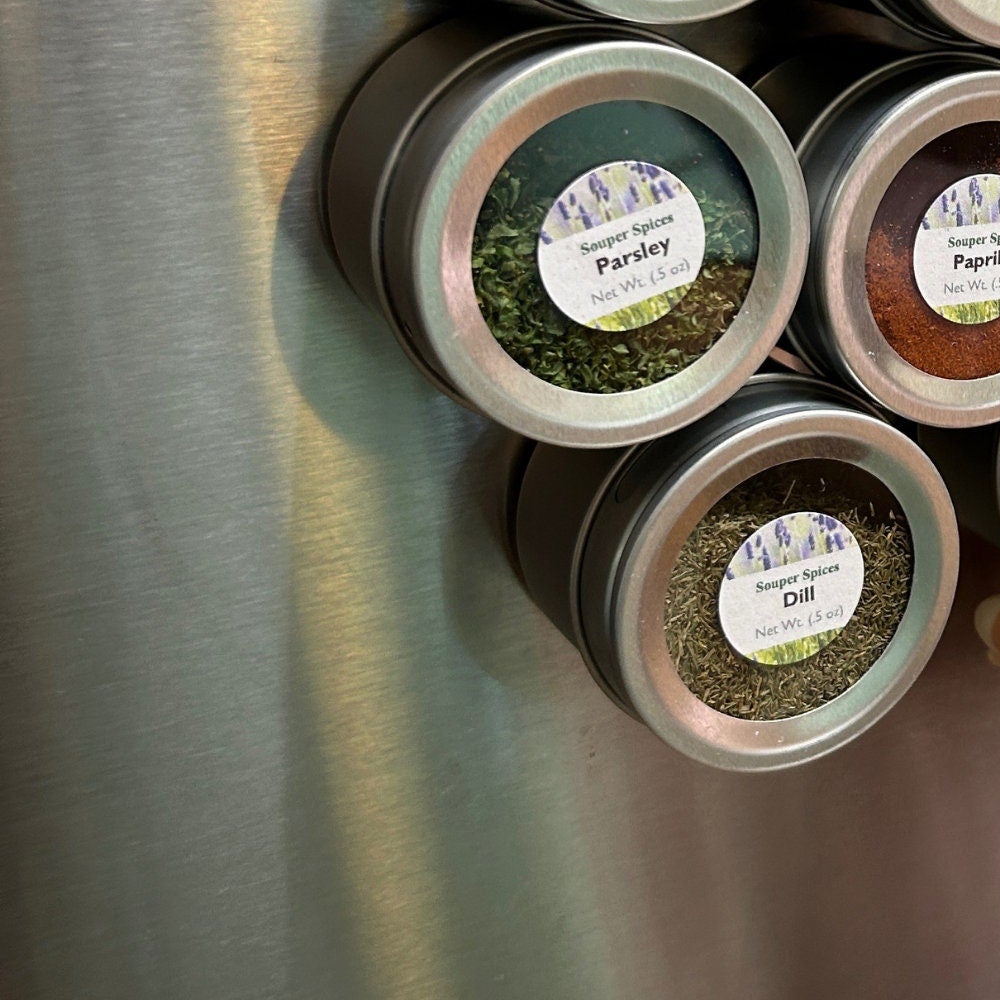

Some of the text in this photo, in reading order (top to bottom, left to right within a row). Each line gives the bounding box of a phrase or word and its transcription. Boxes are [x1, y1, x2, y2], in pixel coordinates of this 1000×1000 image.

[580, 214, 674, 255] Souper Spices
[948, 236, 987, 248] Souper
[595, 238, 670, 275] Parsley
[591, 289, 619, 305] Net
[670, 258, 691, 275] oz)
[944, 282, 964, 295] Net
[756, 563, 840, 593] Souper Spices
[784, 585, 815, 608] Dill
[756, 626, 778, 639] Net
[826, 606, 844, 618] oz)
